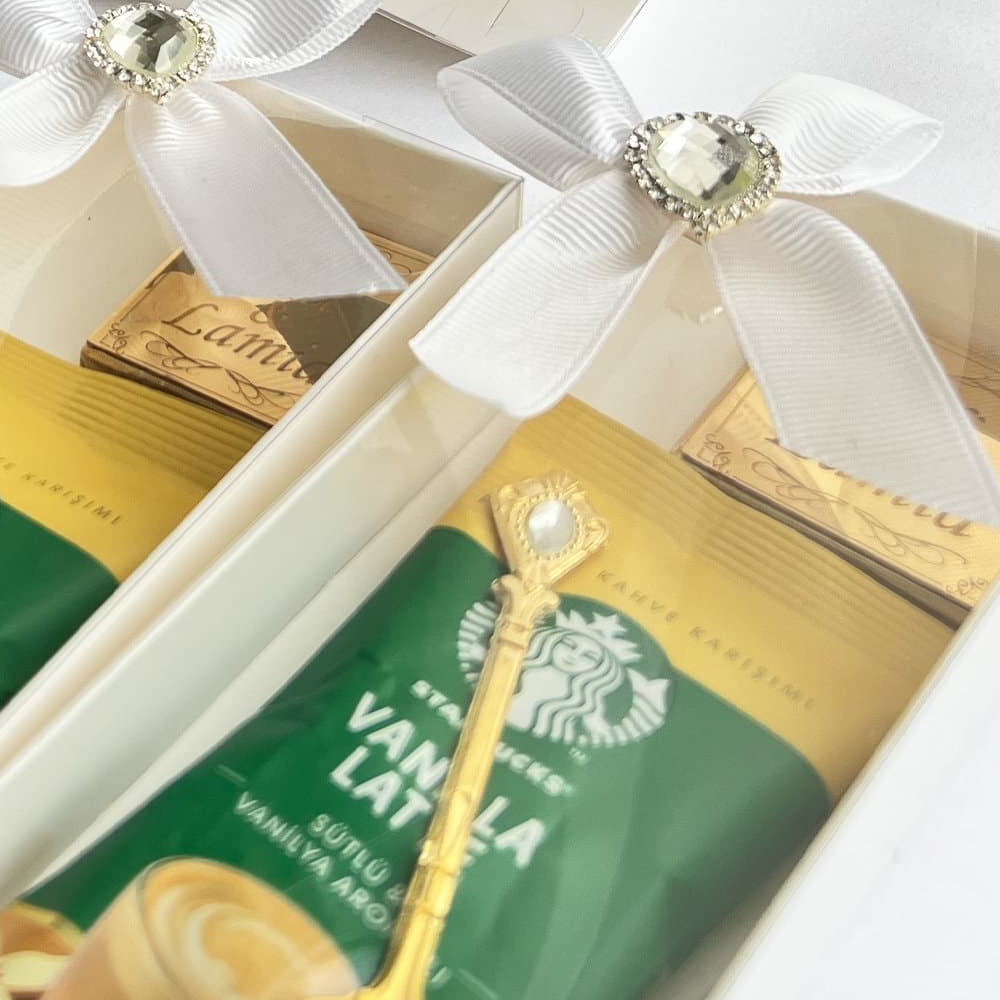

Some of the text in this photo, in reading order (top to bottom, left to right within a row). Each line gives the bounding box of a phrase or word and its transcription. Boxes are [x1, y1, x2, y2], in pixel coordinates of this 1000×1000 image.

[347, 690, 547, 868] VANLA
[410, 679, 567, 797] STAUCKS
[328, 745, 489, 867] LAT
